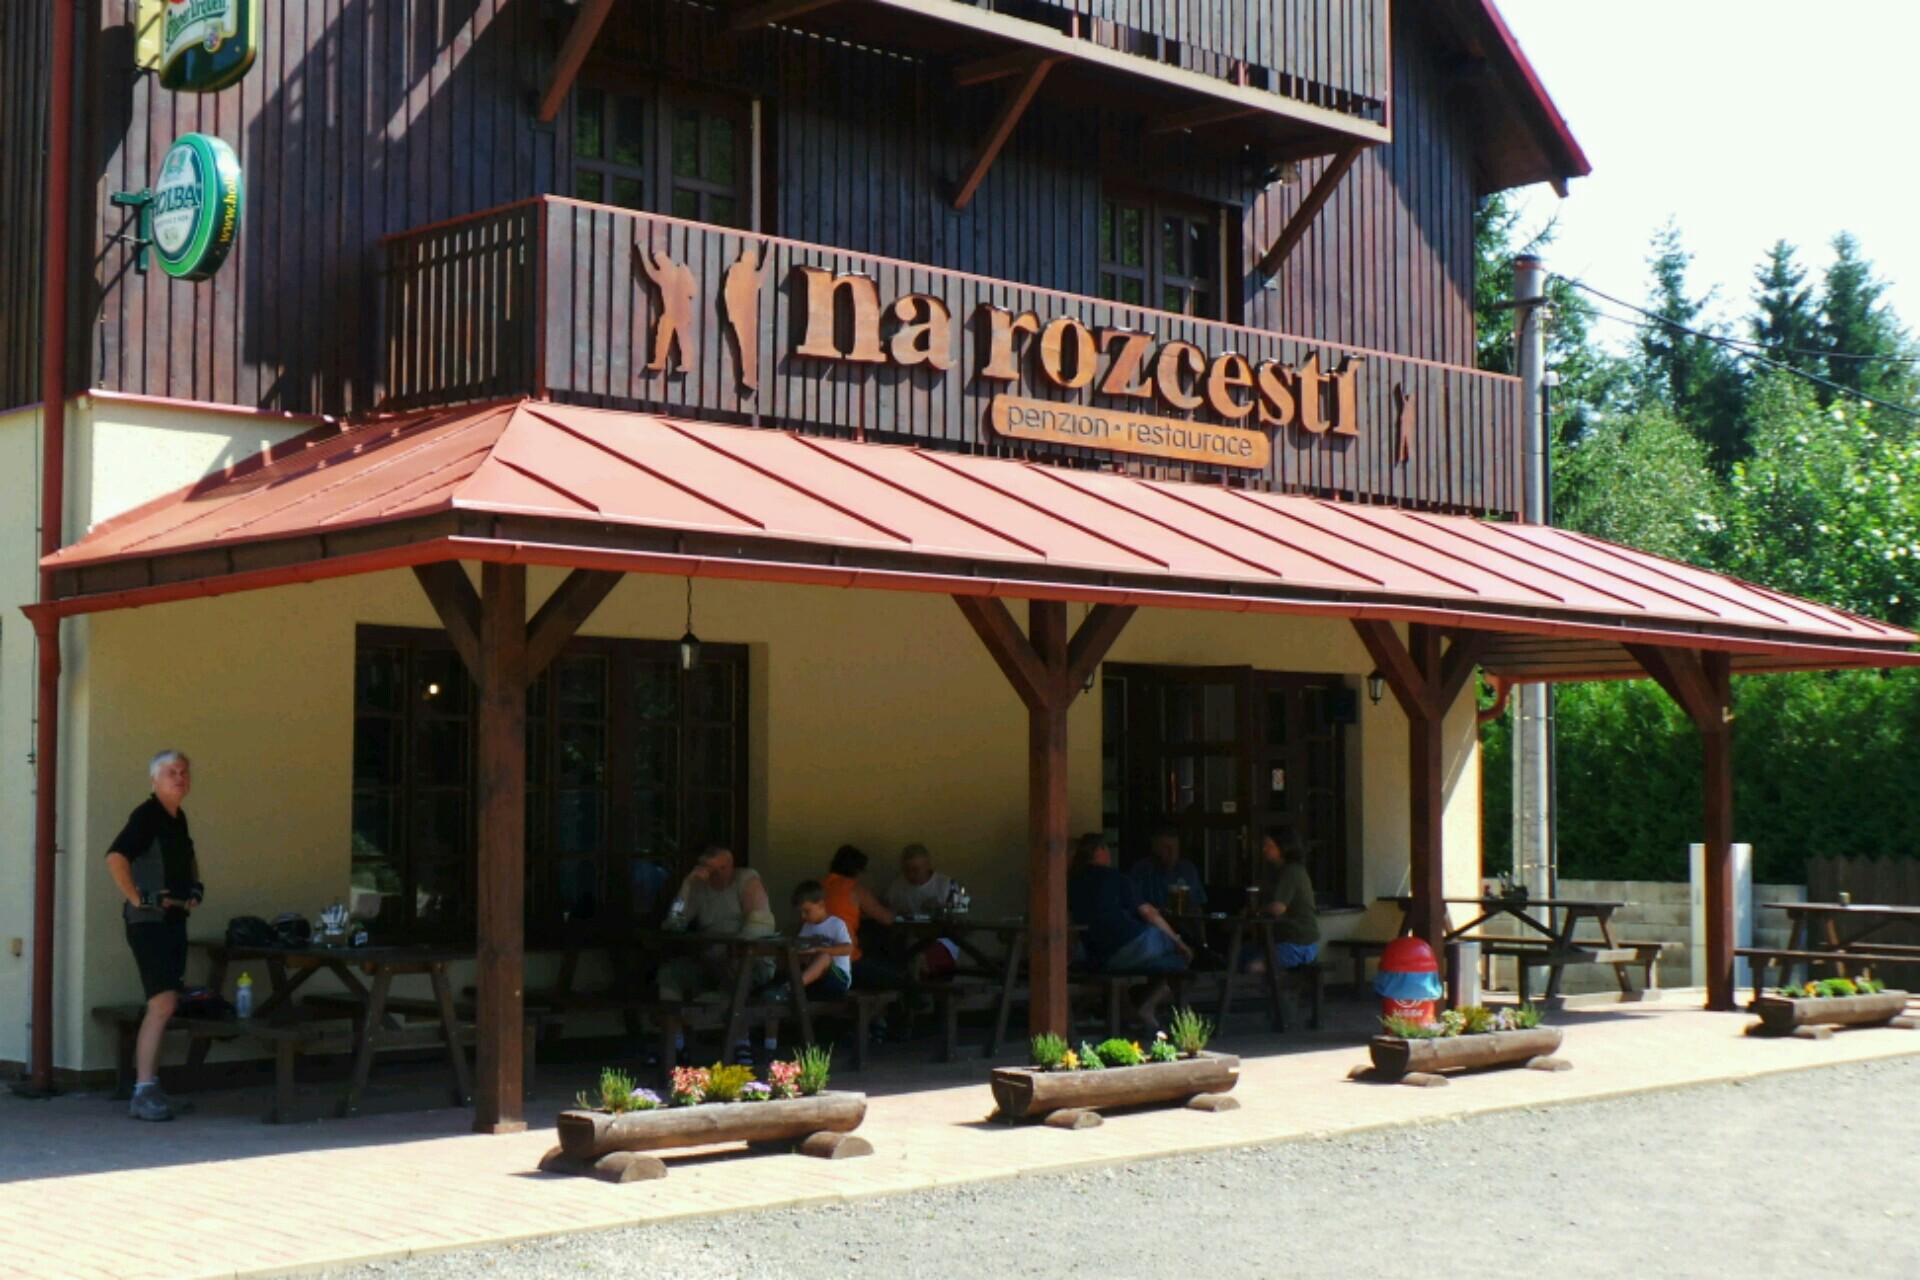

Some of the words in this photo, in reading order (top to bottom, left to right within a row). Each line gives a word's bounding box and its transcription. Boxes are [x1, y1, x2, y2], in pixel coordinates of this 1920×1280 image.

[796, 266, 957, 370] na
[981, 303, 1365, 436] rozcestí
[1008, 404, 1109, 438] penzion
[1127, 422, 1253, 458] restaurace
